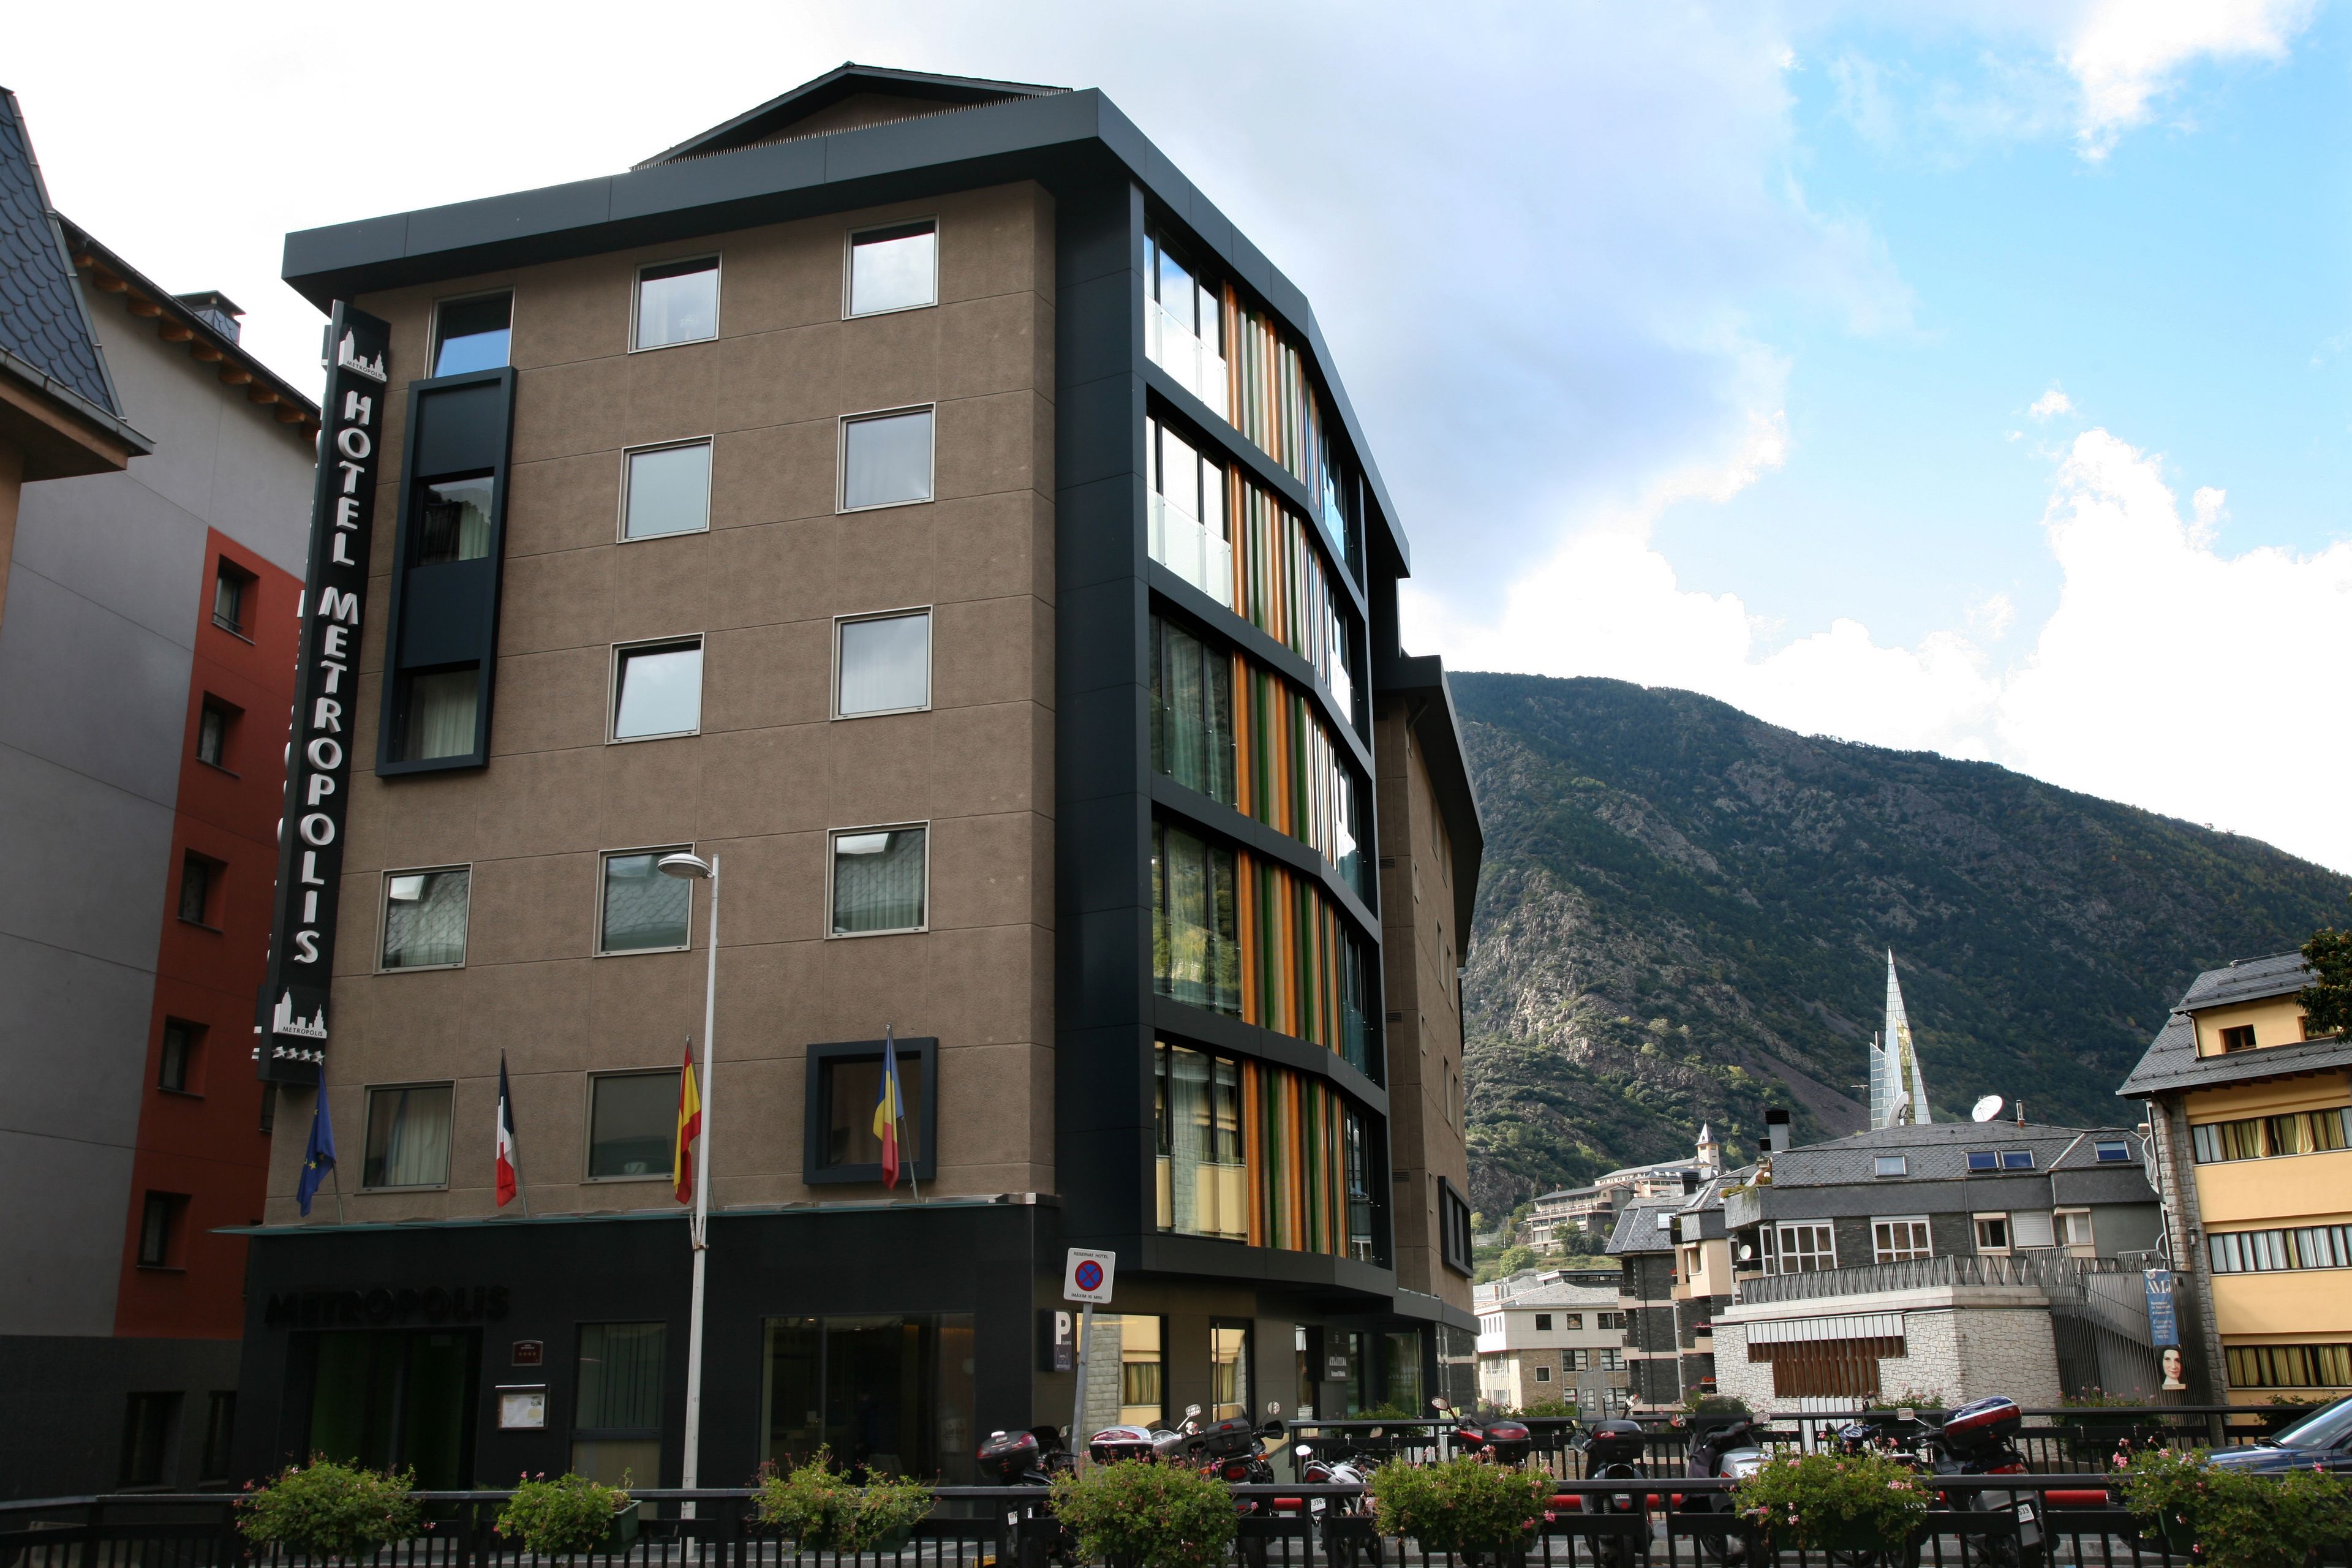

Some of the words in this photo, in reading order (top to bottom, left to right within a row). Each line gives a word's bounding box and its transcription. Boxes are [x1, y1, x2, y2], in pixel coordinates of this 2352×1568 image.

[347, 360, 383, 379] METROPOLIS
[333, 390, 371, 567] HOTEL
[294, 586, 358, 964] METROPOLIS
[282, 1026, 323, 1036] METROPOLIS
[265, 1284, 510, 1325] METROPOLIS
[1055, 1311, 1071, 1344] P
